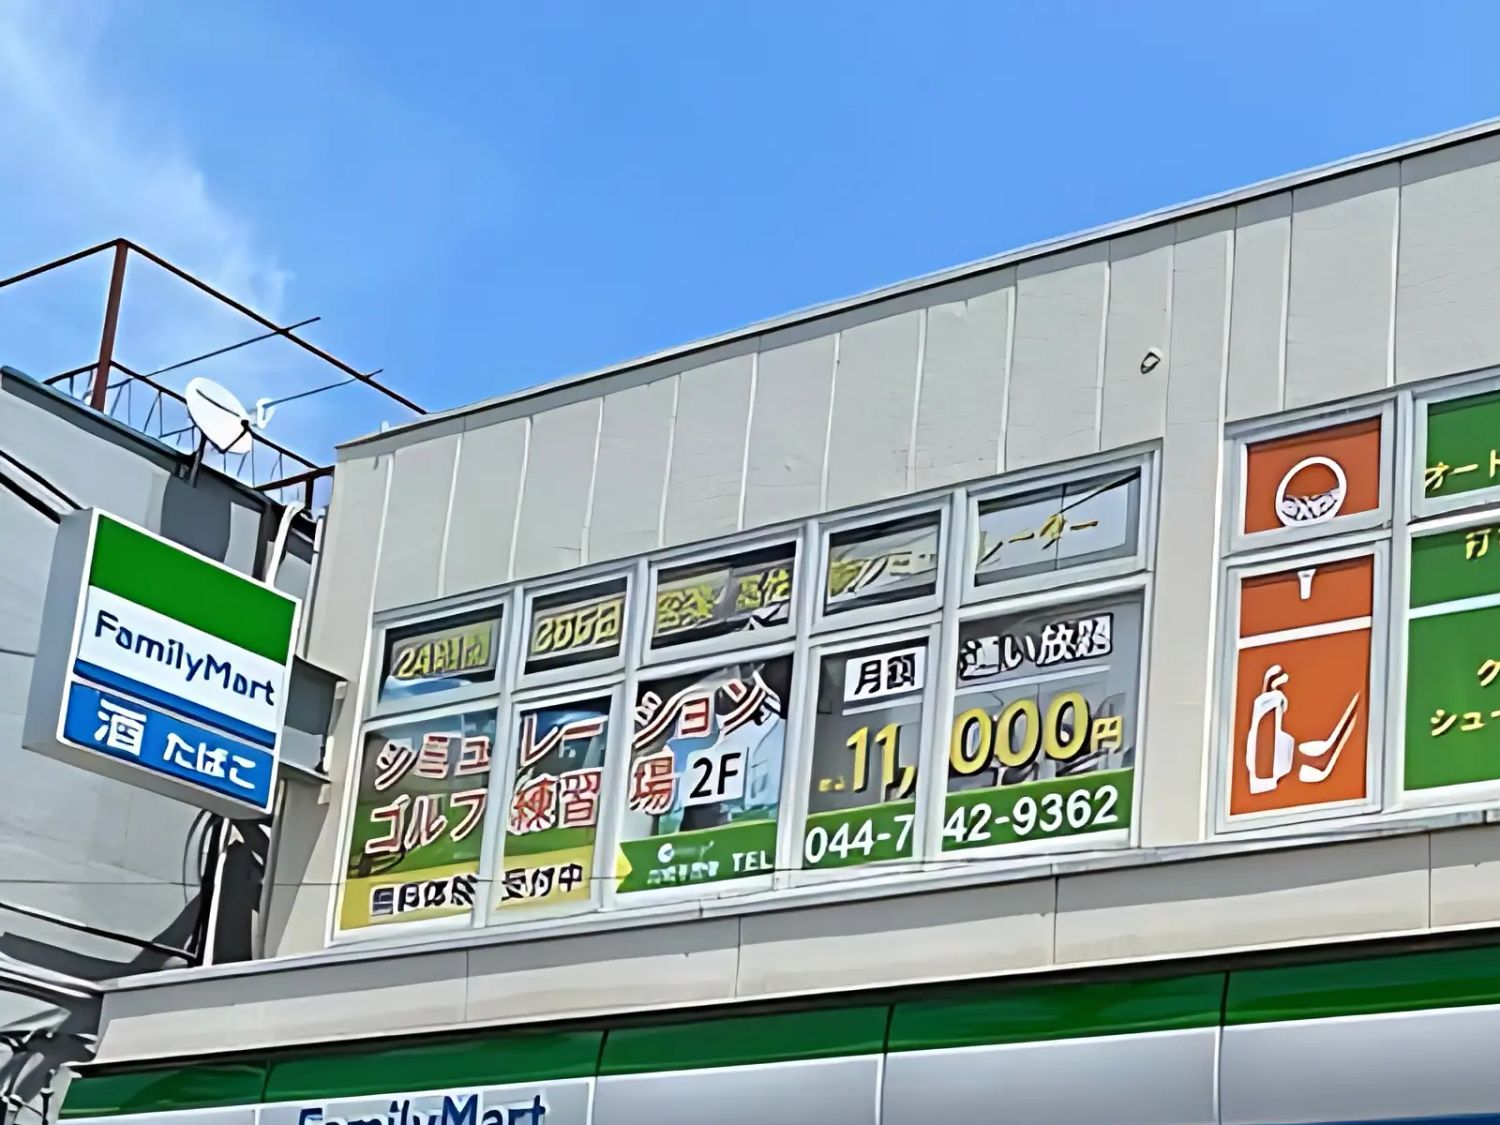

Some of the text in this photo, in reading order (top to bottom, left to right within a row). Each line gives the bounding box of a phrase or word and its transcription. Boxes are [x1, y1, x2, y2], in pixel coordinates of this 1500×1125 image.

[94, 610, 275, 706] FamilyMart
[94, 698, 257, 789] 酒 たばこ
[688, 752, 742, 799] 2F
[732, 849, 775, 873] TEL
[804, 784, 1120, 864] 044-742-9362
